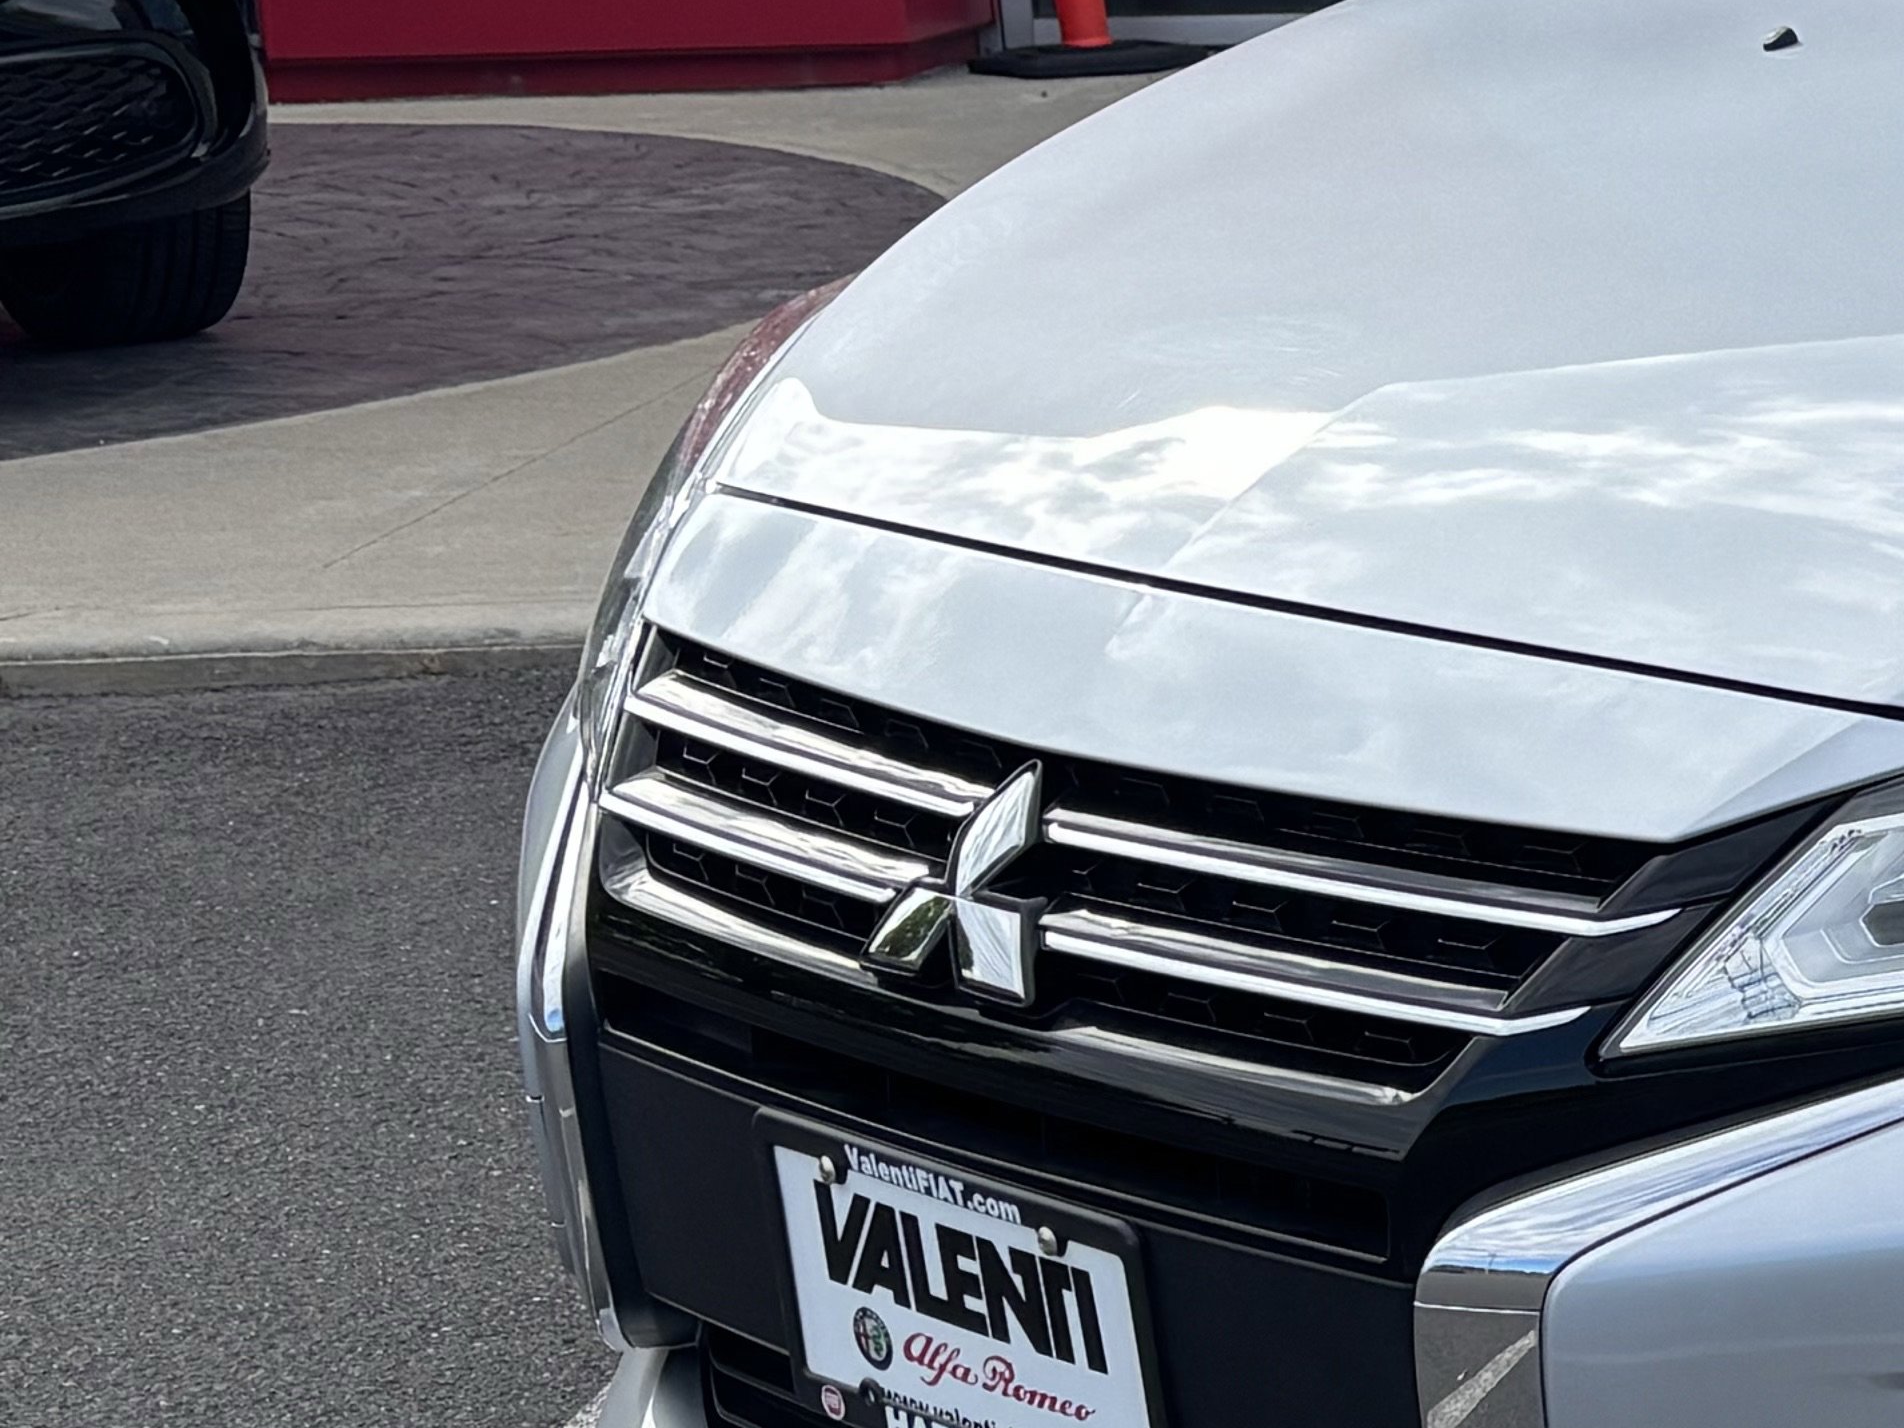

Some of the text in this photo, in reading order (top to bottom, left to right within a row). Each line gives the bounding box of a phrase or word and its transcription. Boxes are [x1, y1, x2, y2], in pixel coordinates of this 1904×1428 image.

[844, 1143, 1022, 1226] ValentiFIAT.com
[813, 1179, 1109, 1375] VALENTI
[902, 1331, 1095, 1423] Alfa Romeo
